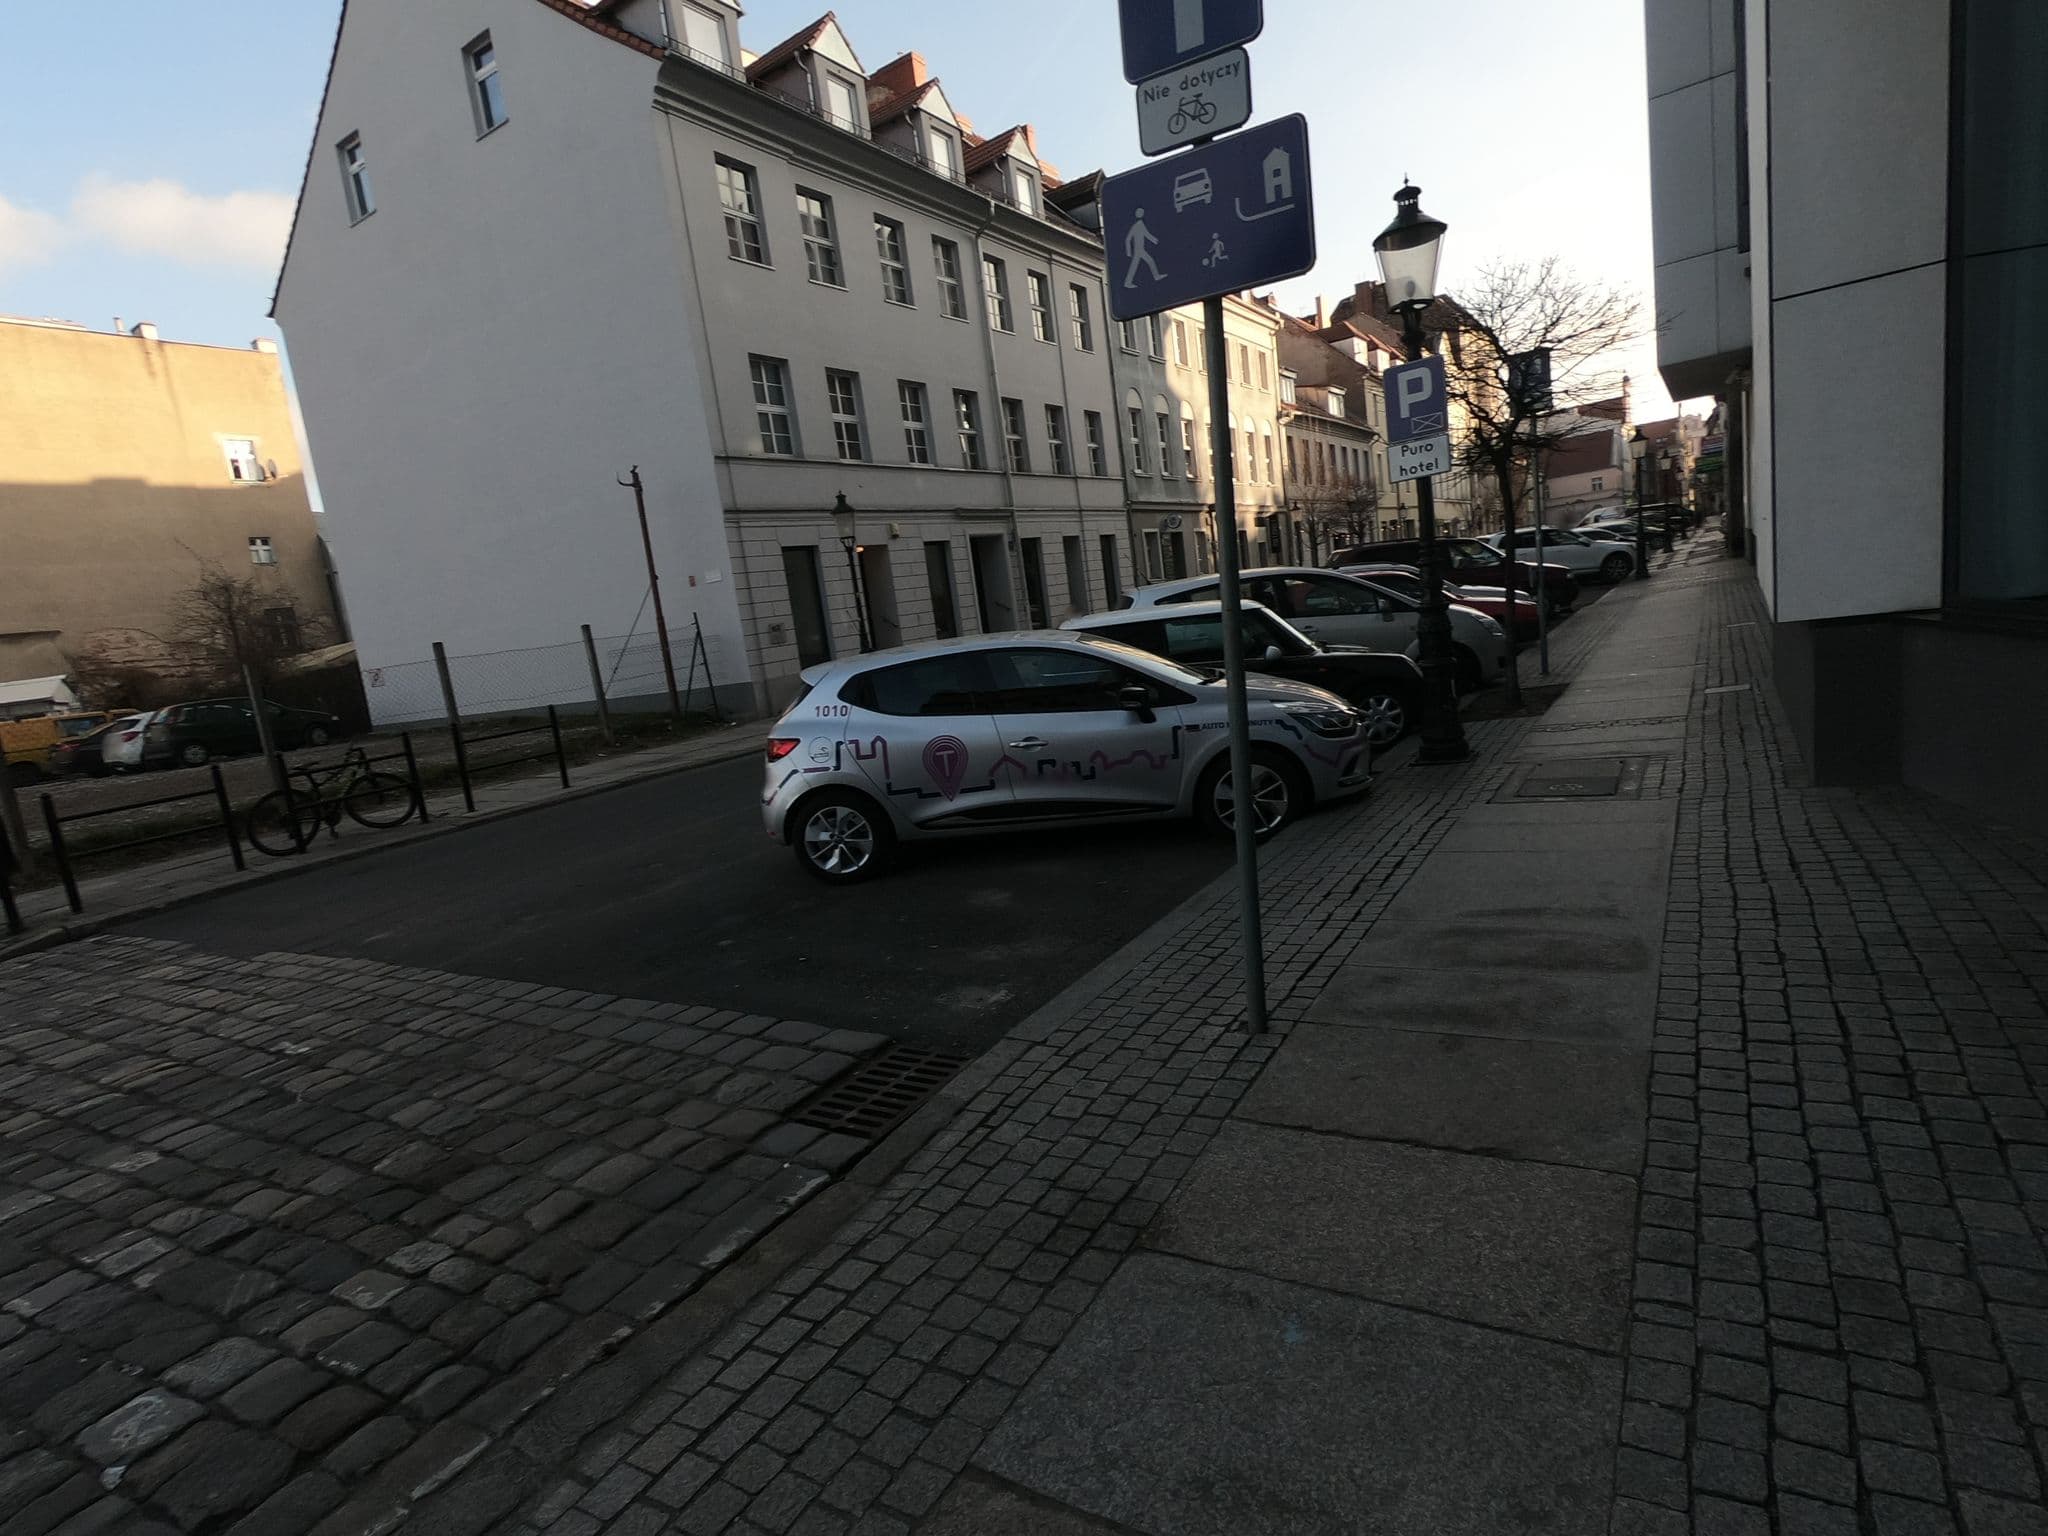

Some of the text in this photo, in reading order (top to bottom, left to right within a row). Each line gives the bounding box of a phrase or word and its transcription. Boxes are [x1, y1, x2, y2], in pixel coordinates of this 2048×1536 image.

[1143, 61, 1240, 104] Nie dotyczy
[1397, 367, 1433, 418] P
[1401, 443, 1434, 458] Puro
[1399, 457, 1439, 477] hotel
[814, 705, 848, 717] 1010
[1202, 722, 1225, 730] AUTO
[935, 749, 955, 777] T
